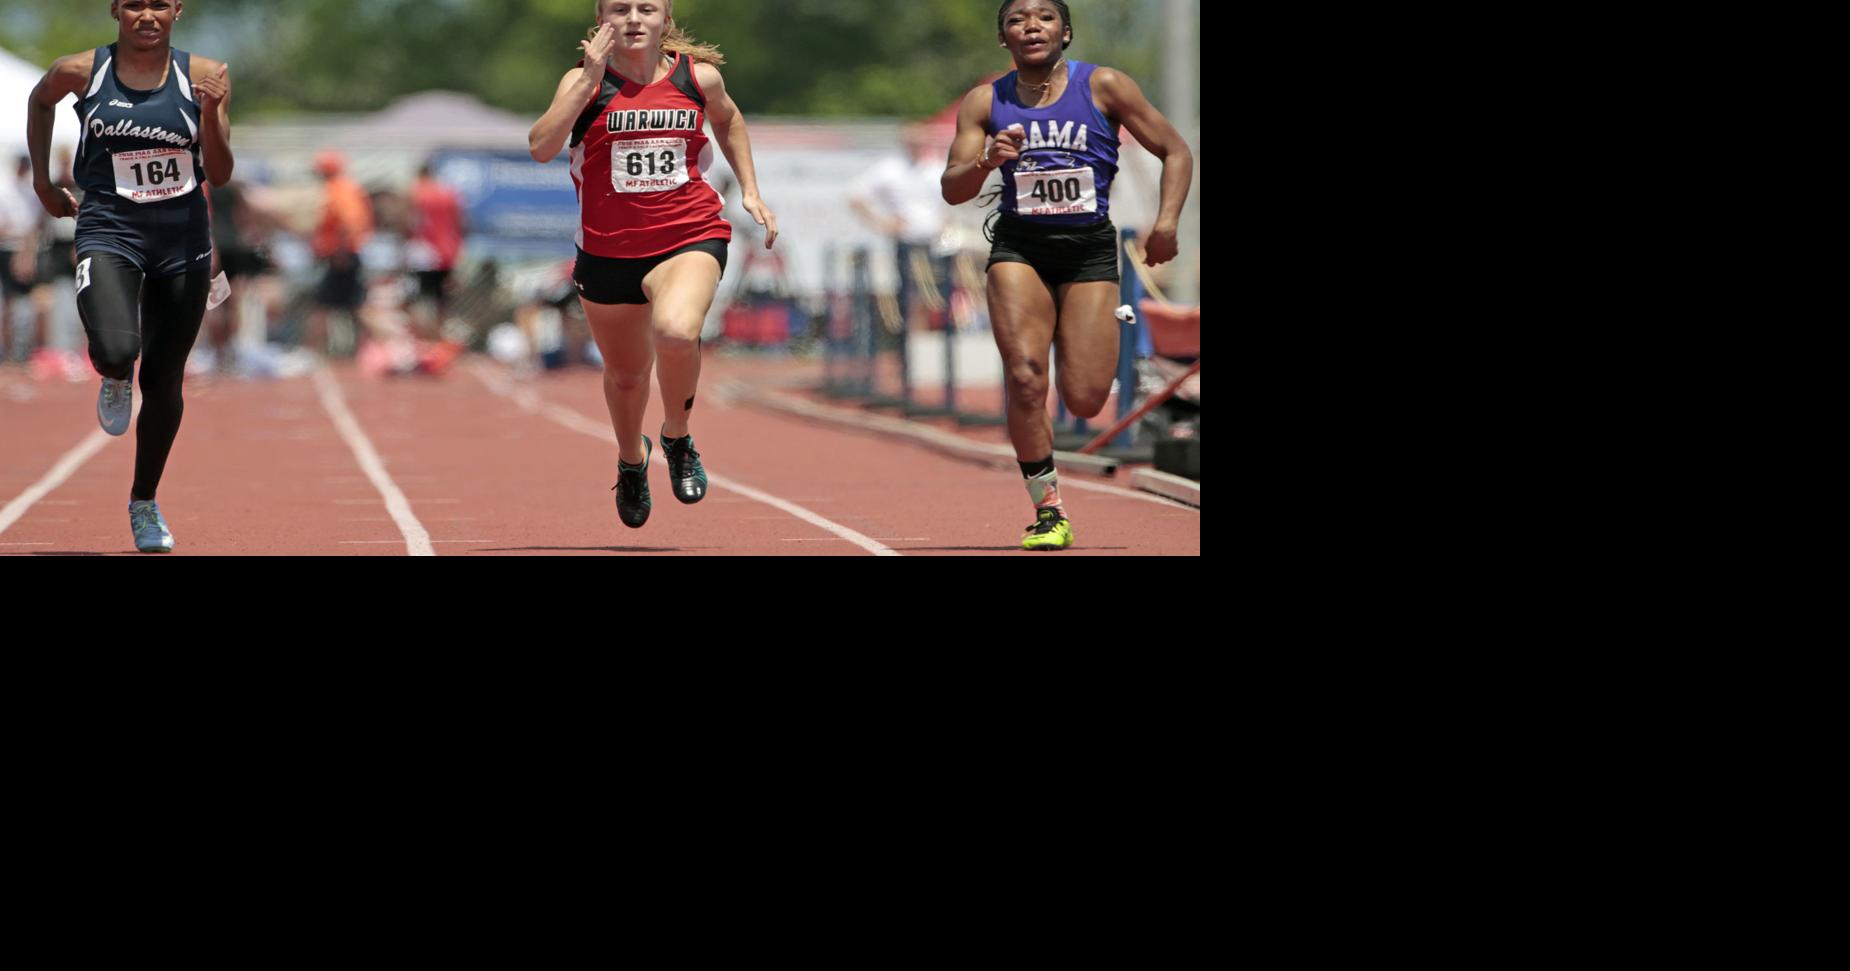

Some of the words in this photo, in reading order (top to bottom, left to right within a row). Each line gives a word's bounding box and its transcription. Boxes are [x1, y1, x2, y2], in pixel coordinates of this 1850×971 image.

[90, 118, 190, 147] Dallastown
[607, 109, 698, 134] WARWICK
[1019, 120, 1088, 151] AMA
[130, 158, 180, 186] 164
[626, 150, 675, 176] 613
[145, 185, 185, 197] ATHLETIC
[639, 178, 678, 187] ATHLETIC
[1031, 177, 1080, 203] 400
